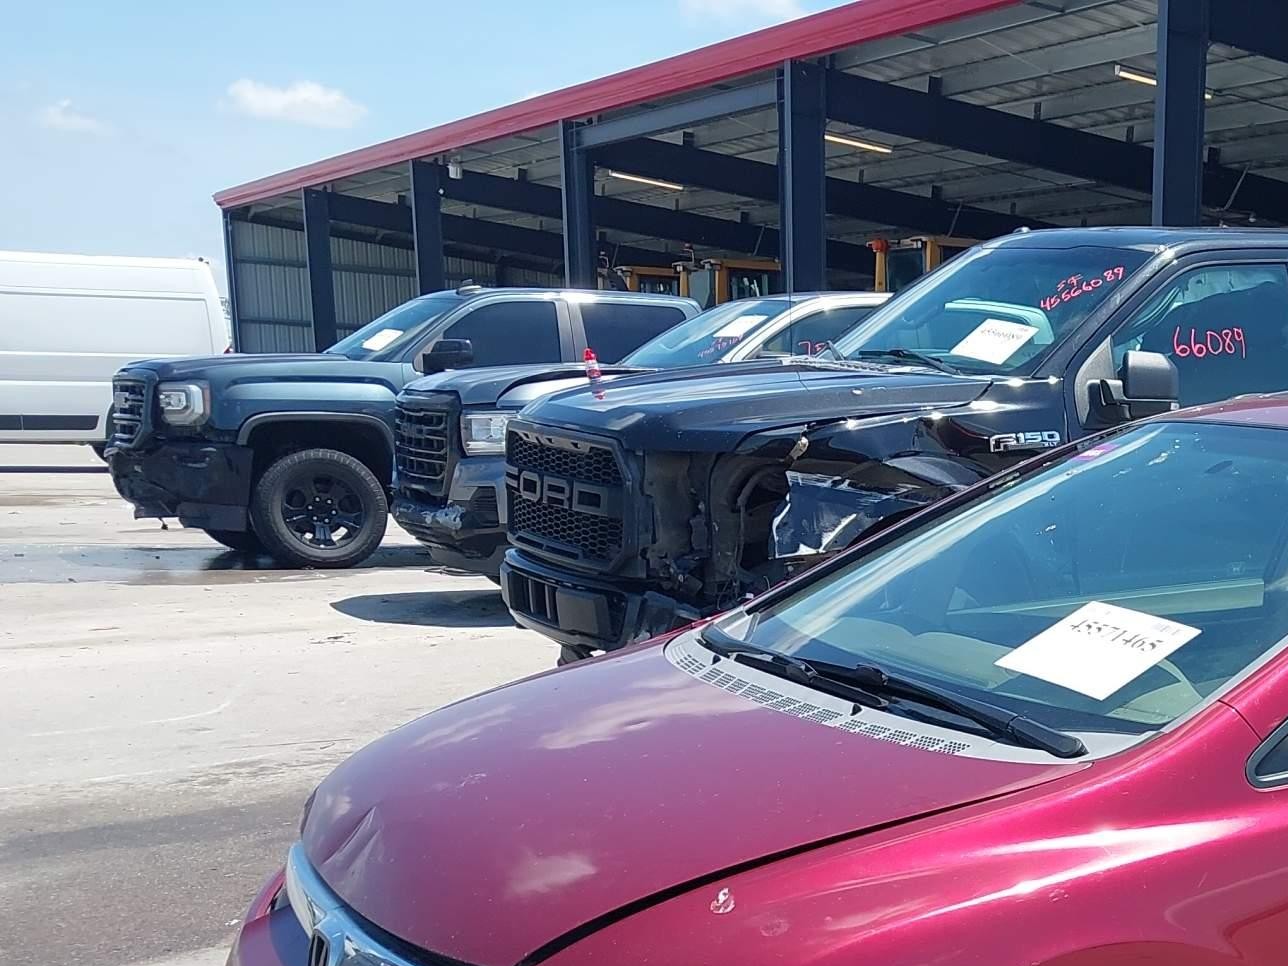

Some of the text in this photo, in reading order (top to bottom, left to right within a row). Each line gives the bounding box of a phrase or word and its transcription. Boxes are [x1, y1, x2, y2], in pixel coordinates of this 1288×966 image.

[1040, 266, 1124, 311] 45566089
[1172, 326, 1247, 359] 66089
[504, 462, 609, 518] FORD
[1069, 619, 1164, 652] 45571465
